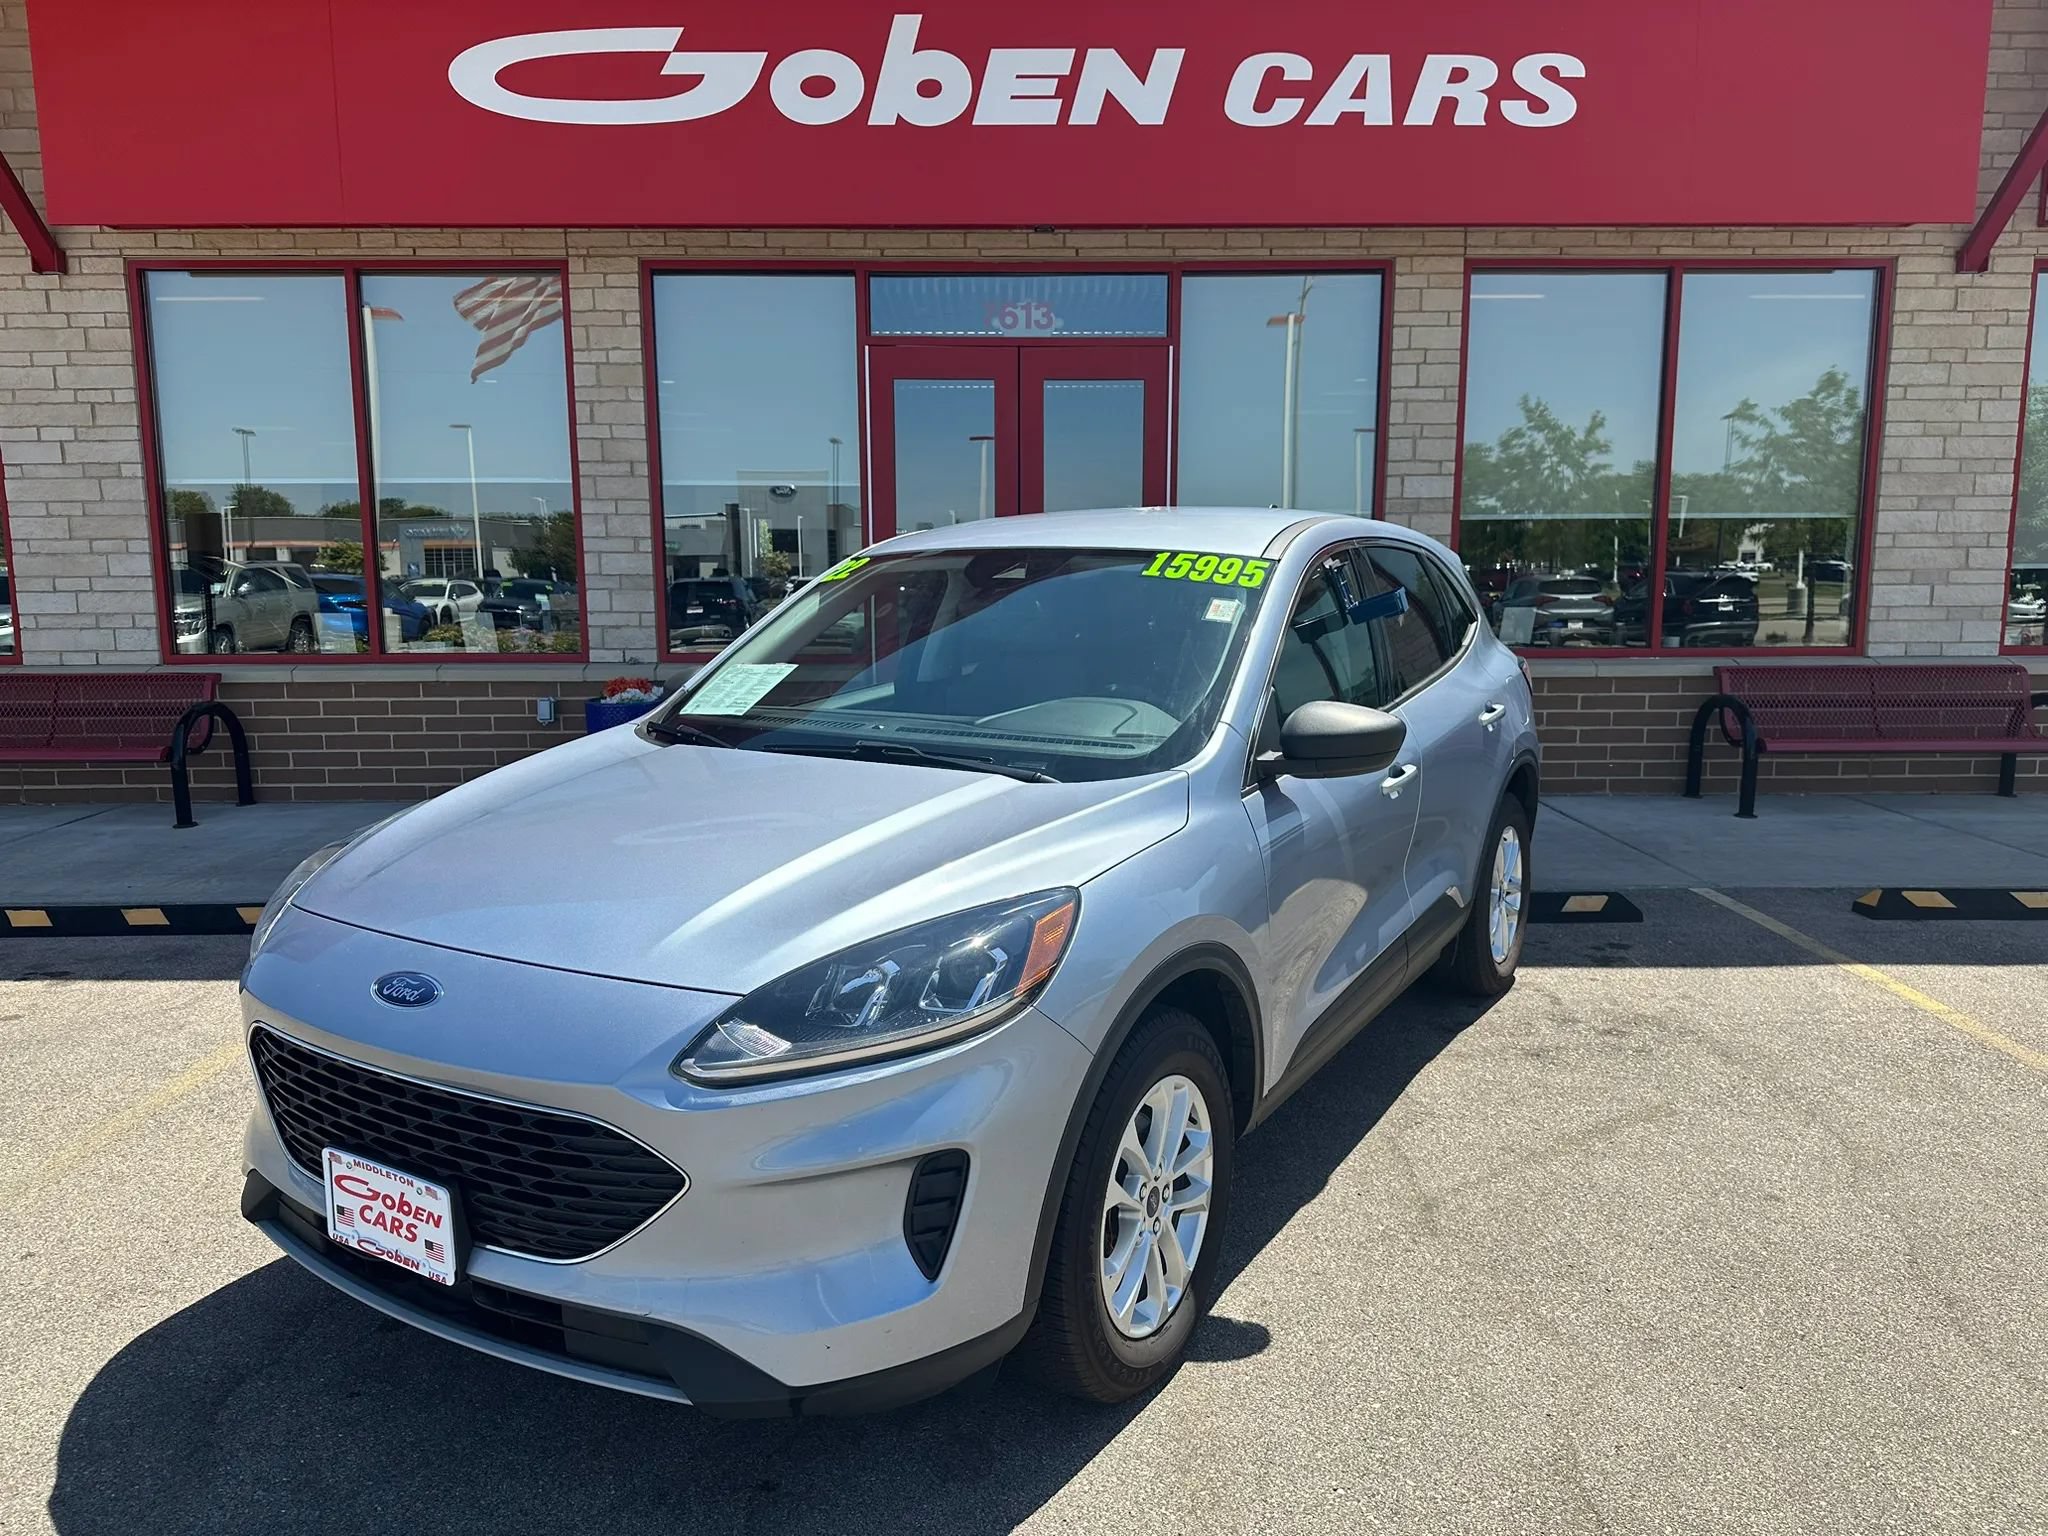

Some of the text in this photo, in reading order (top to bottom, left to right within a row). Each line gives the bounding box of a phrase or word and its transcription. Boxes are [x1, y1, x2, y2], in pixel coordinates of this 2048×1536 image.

[1224, 52, 1587, 127] CARS
[1142, 552, 1270, 588] 15995
[383, 976, 426, 1001] Ford
[353, 1159, 414, 1188] MIDDLETON
[359, 1204, 418, 1243] CARS
[332, 1233, 350, 1246] USA
[428, 1271, 447, 1284] USA
